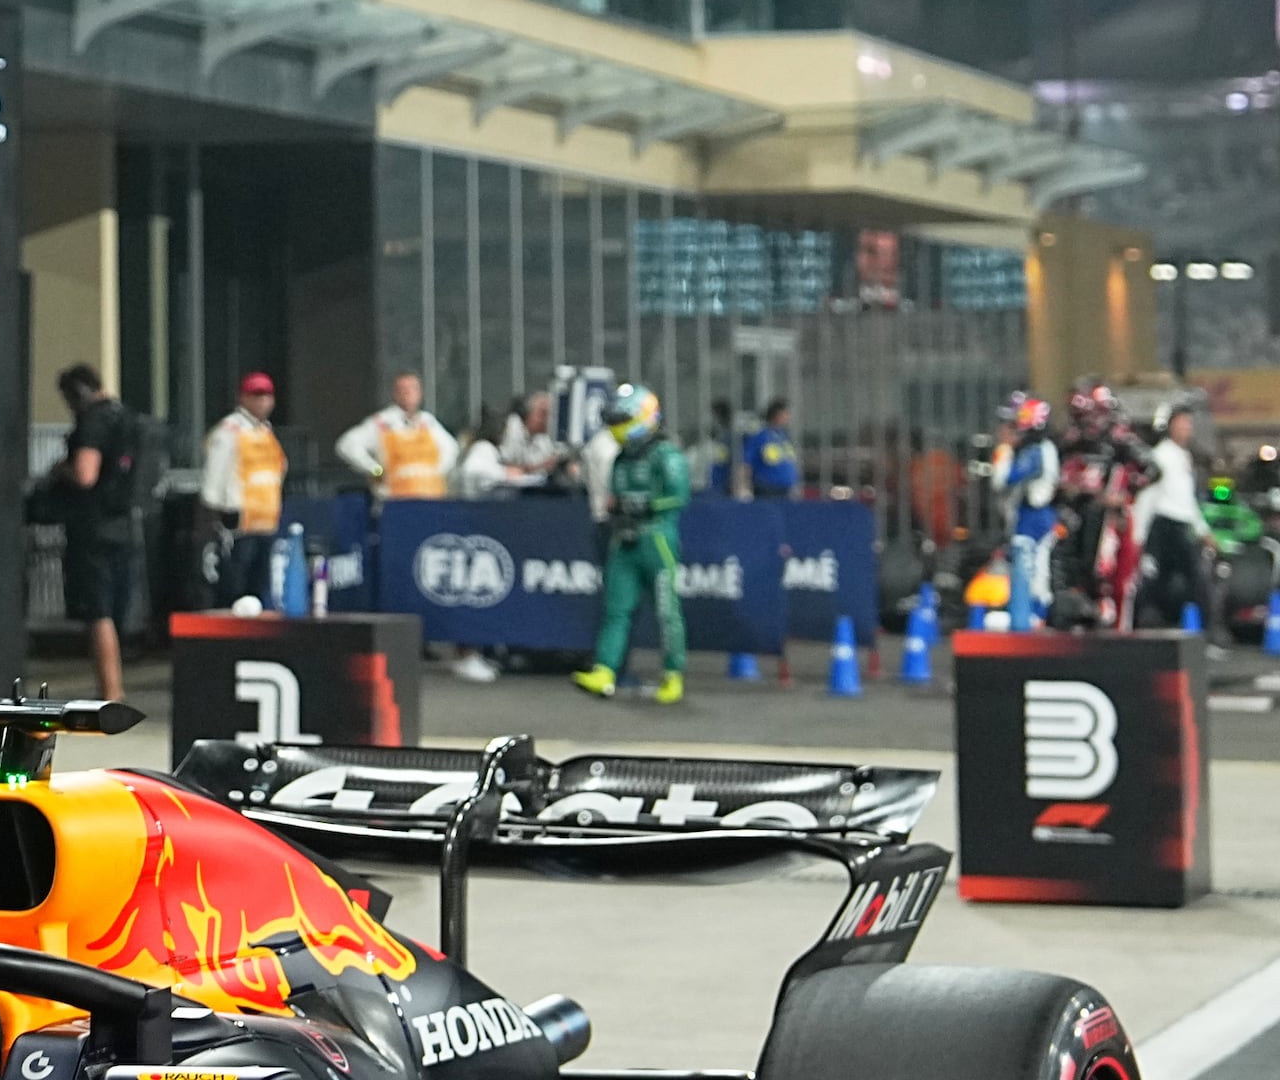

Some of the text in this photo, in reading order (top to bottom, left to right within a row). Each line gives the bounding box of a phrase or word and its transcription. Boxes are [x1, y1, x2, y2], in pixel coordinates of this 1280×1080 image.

[521, 558, 603, 596] PAR
[235, 660, 322, 747] 1
[1024, 680, 1120, 800] 3
[827, 871, 919, 941] Mobil
[412, 997, 542, 1067] HONDA
